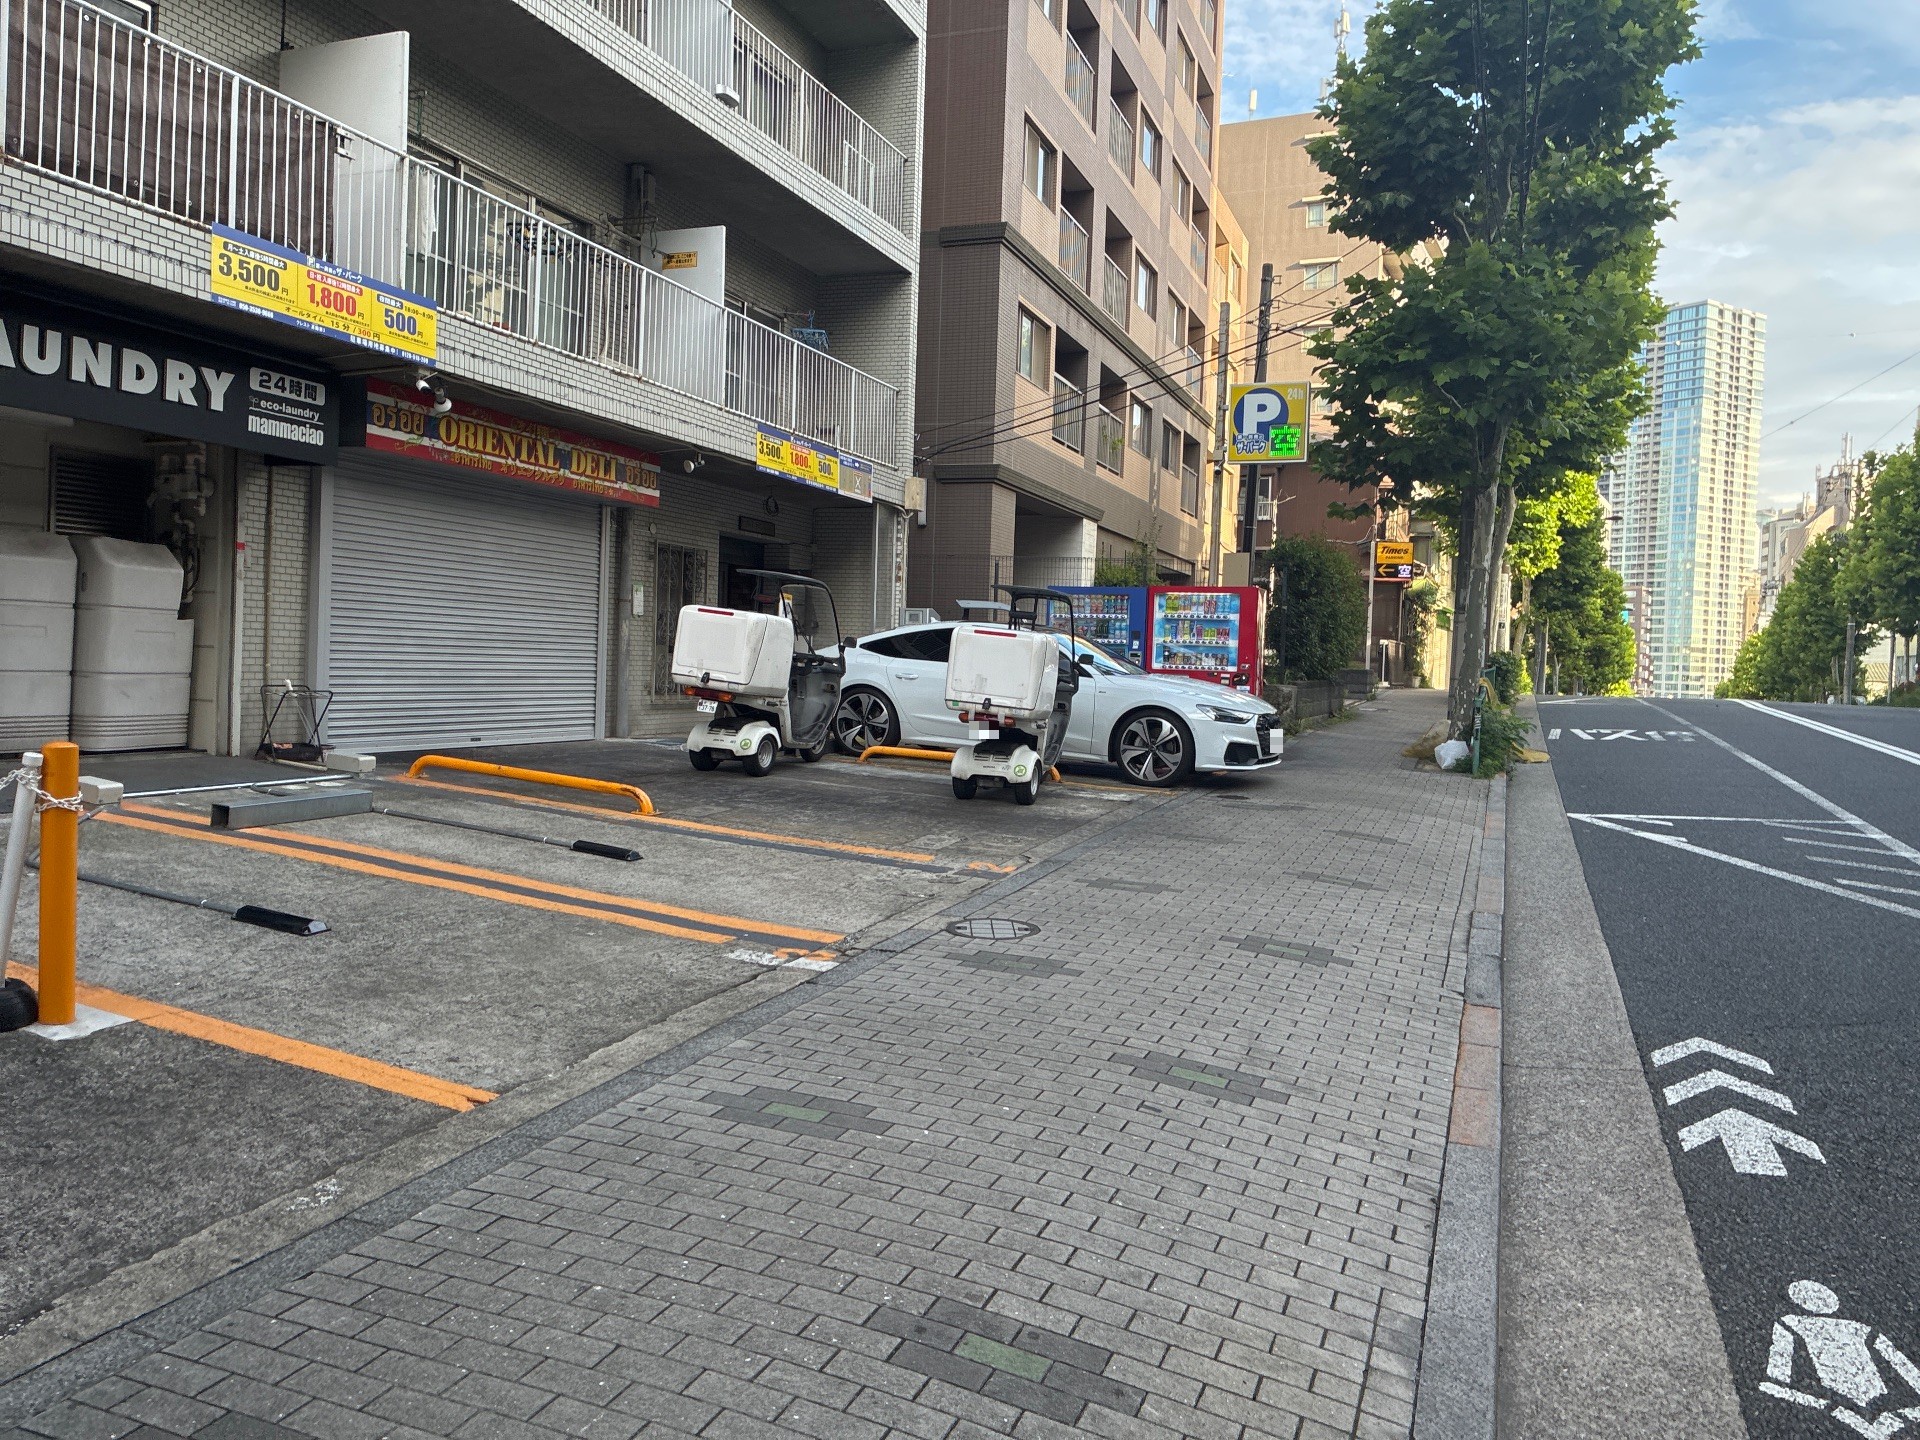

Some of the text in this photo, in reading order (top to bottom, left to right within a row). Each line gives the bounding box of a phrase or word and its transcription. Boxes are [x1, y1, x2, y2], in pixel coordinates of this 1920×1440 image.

[285, 306, 324, 323] オールタイム
[258, 371, 318, 402] 24時間
[1287, 387, 1304, 400] 24h
[260, 400, 320, 422] eco-laundry
[1243, 392, 1282, 437] P
[248, 414, 324, 446] mammaciao
[439, 415, 618, 482] ORIENTAL DELI
[1235, 440, 1266, 455] ザ・パーク
[1380, 546, 1409, 555] Times
